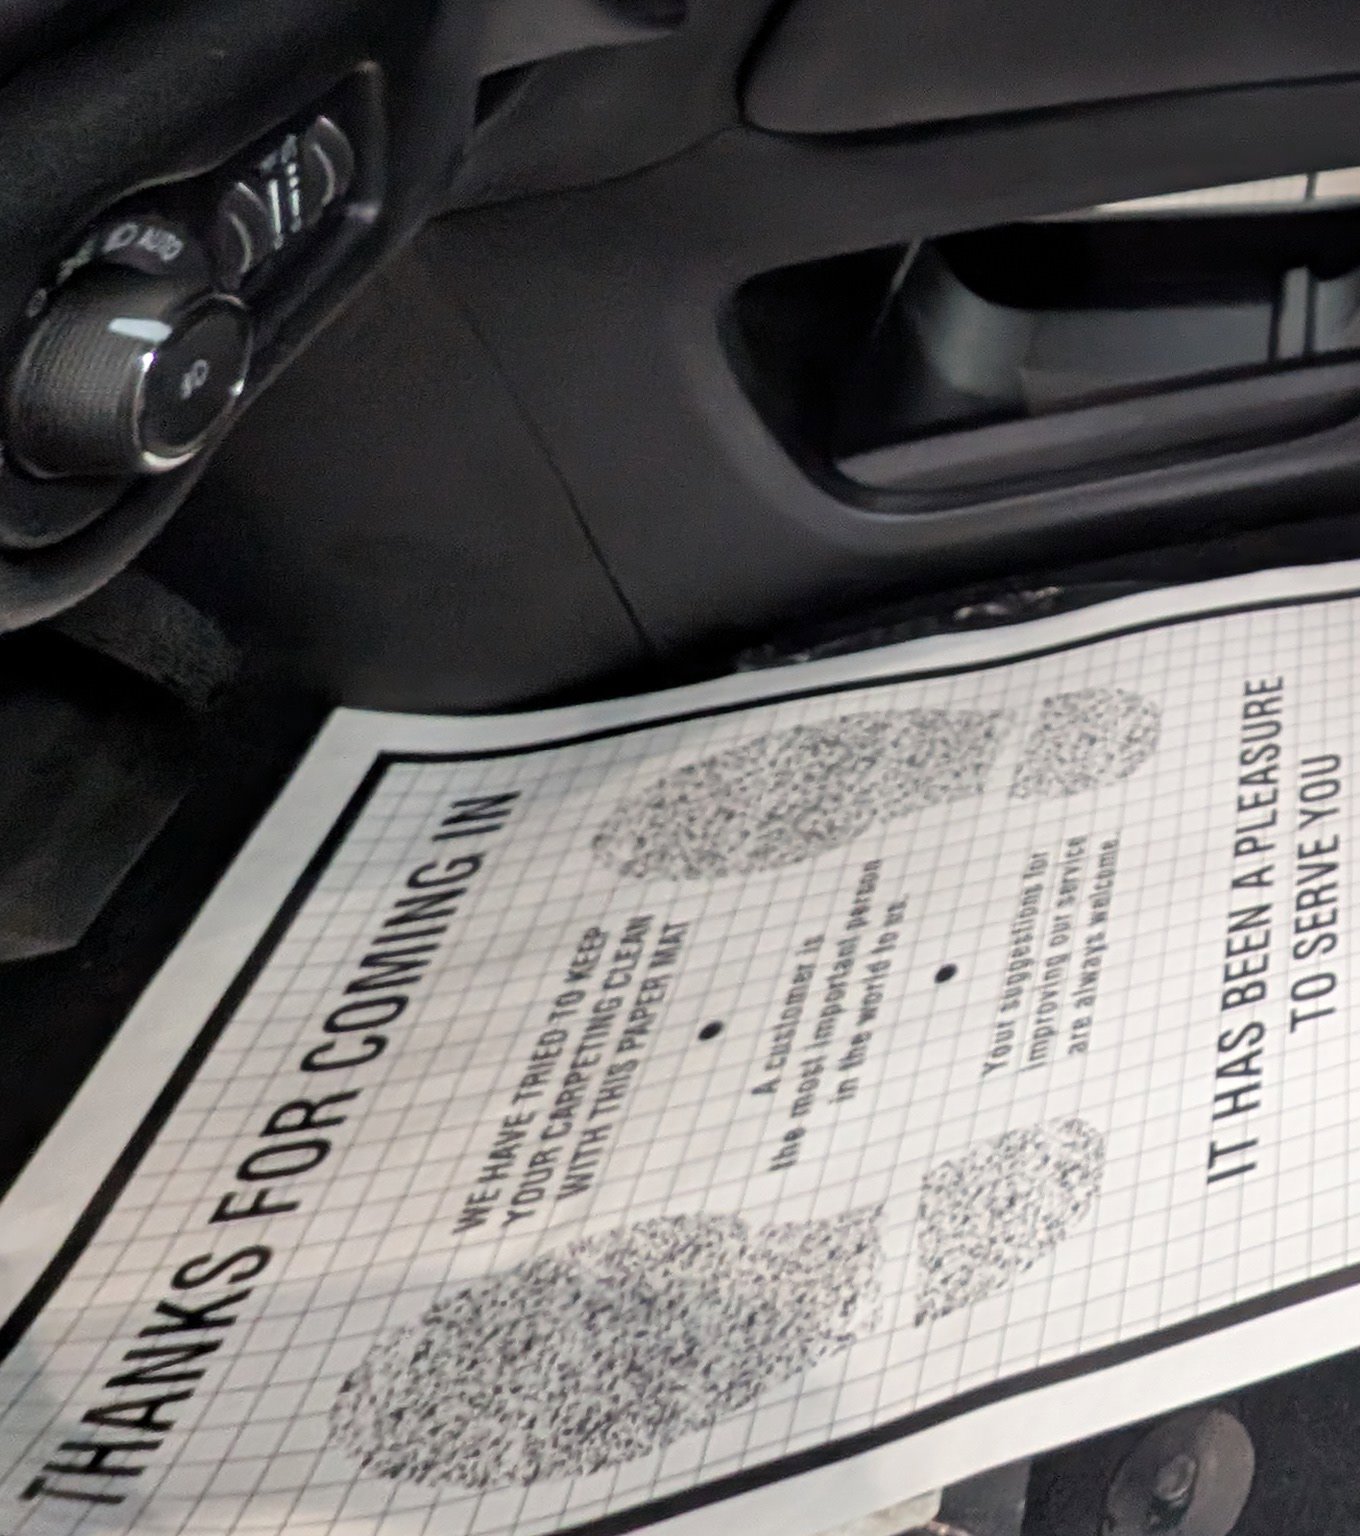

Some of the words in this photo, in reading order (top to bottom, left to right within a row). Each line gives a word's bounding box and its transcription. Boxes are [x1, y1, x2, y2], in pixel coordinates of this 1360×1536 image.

[1235, 675, 1283, 857] PLEASURE
[1298, 752, 1343, 827] YOU
[845, 858, 881, 931] person
[1057, 834, 1088, 908] service
[1089, 830, 1121, 927] welcome.
[1232, 864, 1275, 889] A
[1294, 834, 1340, 955] SERVE
[801, 933, 826, 955] is
[872, 928, 899, 958] to
[883, 894, 908, 928] us.
[1049, 914, 1071, 948] our
[564, 926, 608, 984] KEEP
[982, 1020, 1015, 1076] Your
[1000, 882, 1043, 1013] suggestions
[1022, 851, 1048, 879] for
[1071, 930, 1108, 1009] always
[1222, 901, 1272, 1011] BEEN
[548, 990, 586, 1025] TO
[765, 961, 819, 1072] customer
[803, 935, 861, 1052] important
[856, 959, 890, 1027] world
[1290, 972, 1338, 1033] TO
[512, 1028, 568, 1106] TRIED
[556, 1124, 612, 1202] WITH
[590, 1058, 636, 1120] THIS
[617, 974, 672, 1055] PAPER
[650, 920, 689, 969] MAT
[838, 1029, 872, 1074] the
[1068, 1016, 1092, 1055] are
[1212, 1019, 1265, 1121] HAS
[502, 1148, 559, 1230] YOUR
[541, 994, 623, 1141] CARPETING
[602, 913, 655, 992] CLEAN
[751, 1077, 780, 1096] A
[790, 1054, 826, 1120] most
[829, 1076, 859, 1105] in
[17, 1242, 273, 1507] THANKS
[208, 1087, 360, 1227] FOR
[300, 850, 486, 1078] COMING
[432, 789, 522, 842] IN
[478, 1109, 536, 1184] HAVE
[769, 1126, 806, 1173] the
[1207, 1139, 1259, 1185] IT
[452, 1188, 500, 1235] WE
